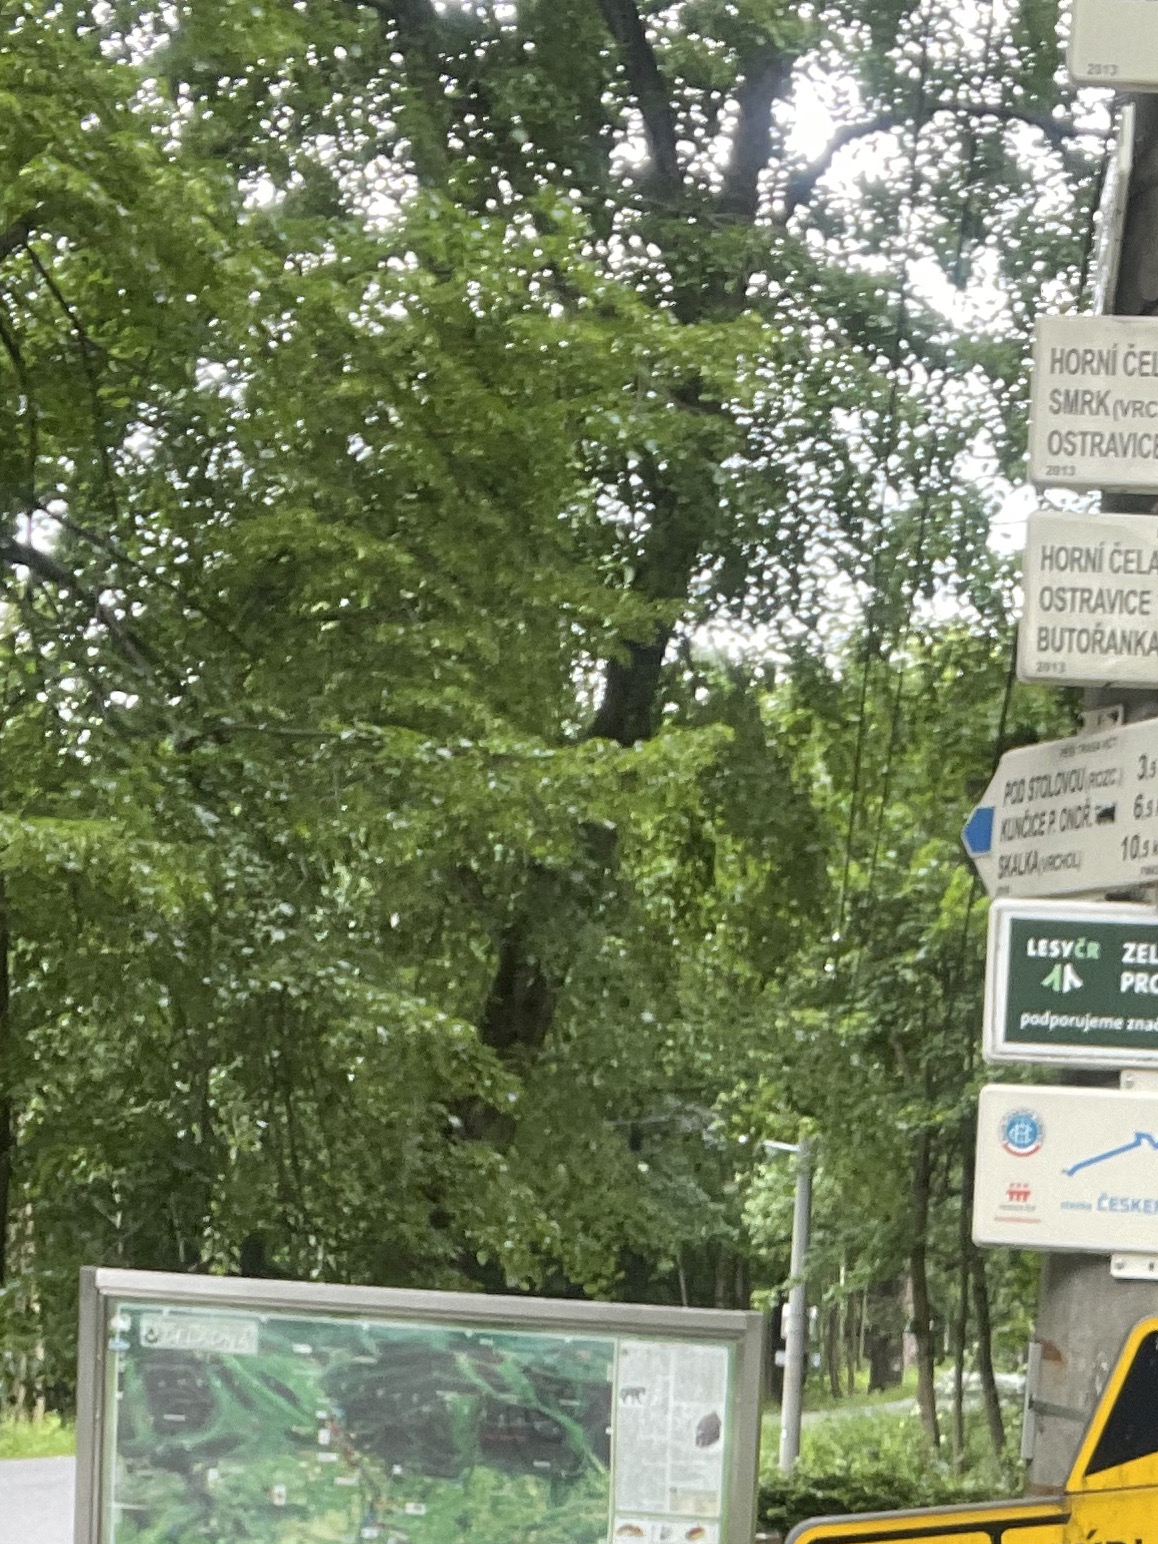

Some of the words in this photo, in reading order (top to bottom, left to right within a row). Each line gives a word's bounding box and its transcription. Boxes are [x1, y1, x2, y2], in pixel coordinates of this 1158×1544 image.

[1049, 343, 1117, 378] HORNÍ
[1048, 388, 1111, 418] SMRK
[1040, 541, 1105, 575] HORNÍ
[1039, 585, 1151, 617] OSTRAVICE
[1020, 1010, 1123, 1033] podporujeme
